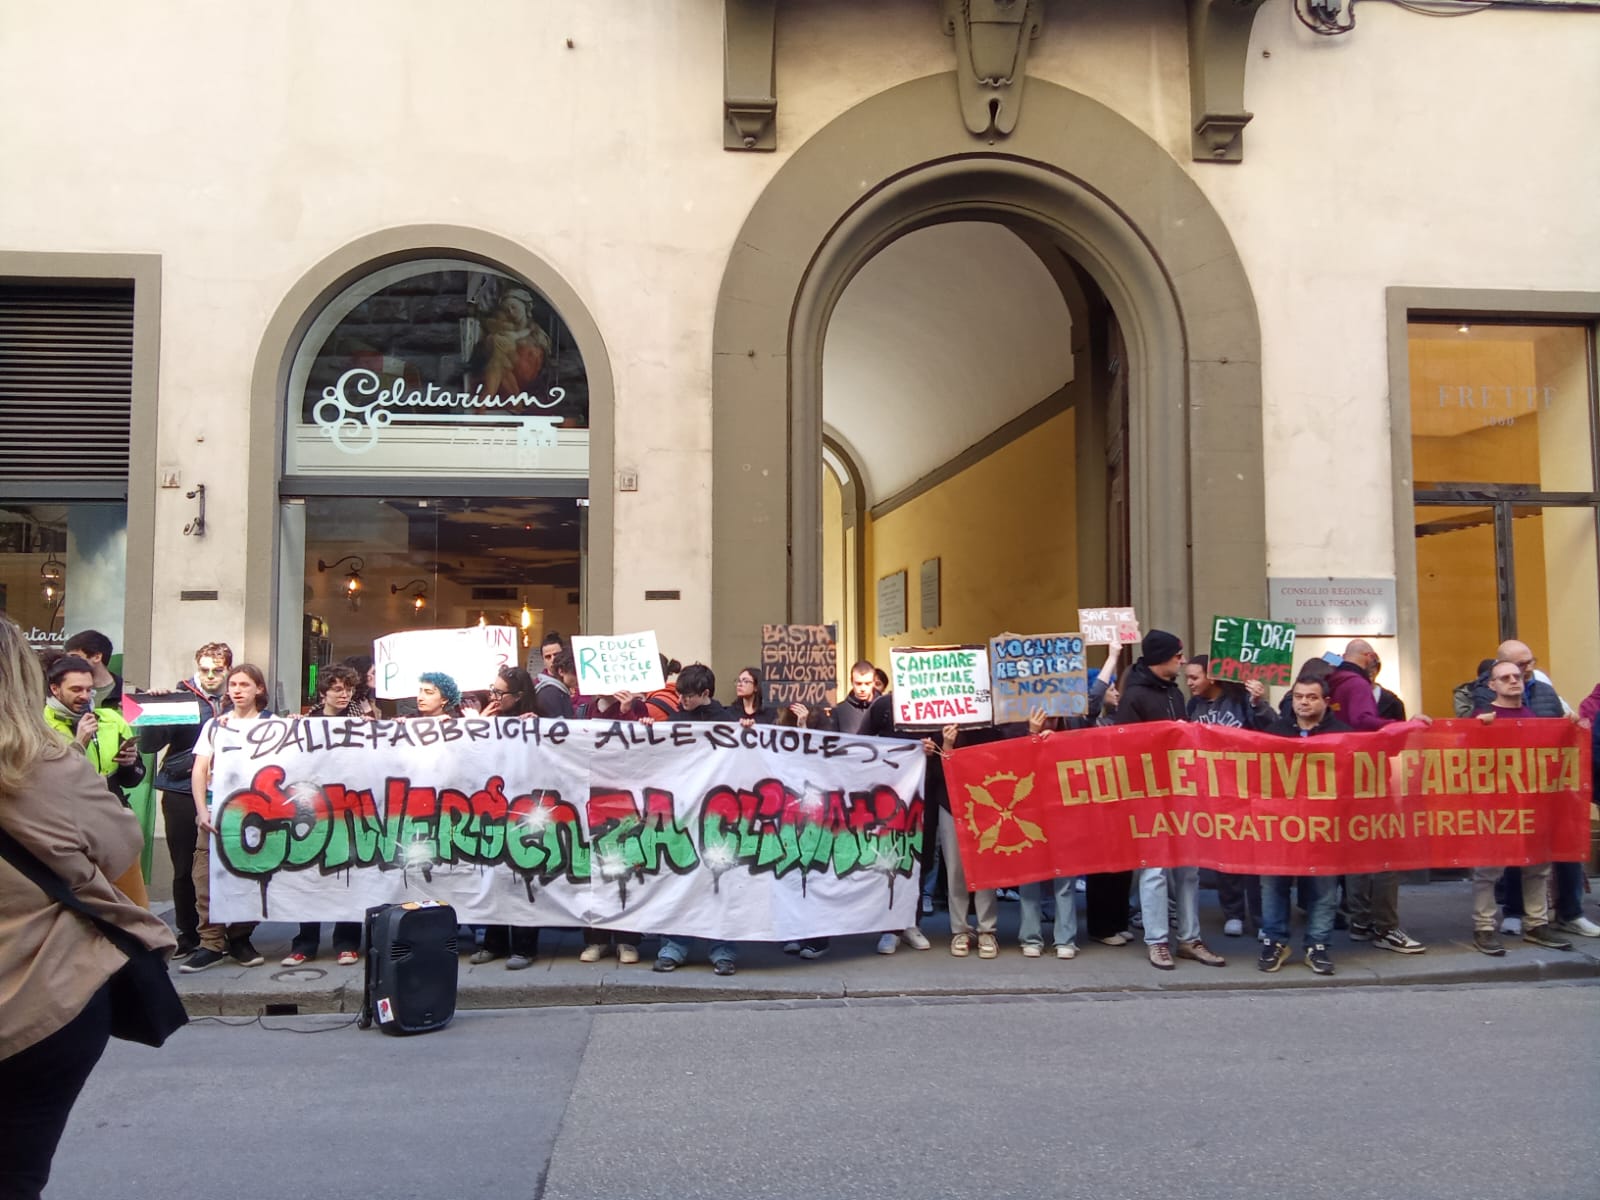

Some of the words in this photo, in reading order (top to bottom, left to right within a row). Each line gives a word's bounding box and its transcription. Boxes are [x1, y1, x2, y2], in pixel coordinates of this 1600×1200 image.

[1281, 586, 1329, 596] CONSIGLIO
[1332, 586, 1384, 596] REGIONALE
[1296, 599, 1326, 608] DELLA
[1329, 599, 1369, 608] TOSCANA
[1081, 610, 1111, 622] SAVE
[763, 624, 832, 644] BASTA
[1082, 624, 1117, 642] PLANET
[896, 652, 977, 672] CAMBIARE
[1240, 647, 1261, 663] DI
[765, 665, 780, 680] IL
[782, 665, 836, 683] NOSTRO
[769, 682, 826, 704] FUTURO
[911, 686, 937, 699] NON
[940, 685, 975, 697] FARLO
[914, 697, 979, 720] FATALE
[594, 721, 697, 750] ALLE
[703, 722, 849, 758] SCUOLE
[1056, 749, 1337, 806] COLLETTIVO
[1353, 751, 1386, 799] DI
[1401, 747, 1581, 796] FABBRICA
[1128, 811, 1340, 843] LAVORATORI
[1349, 812, 1405, 842] GKN
[1413, 809, 1536, 838] FIRENZE
